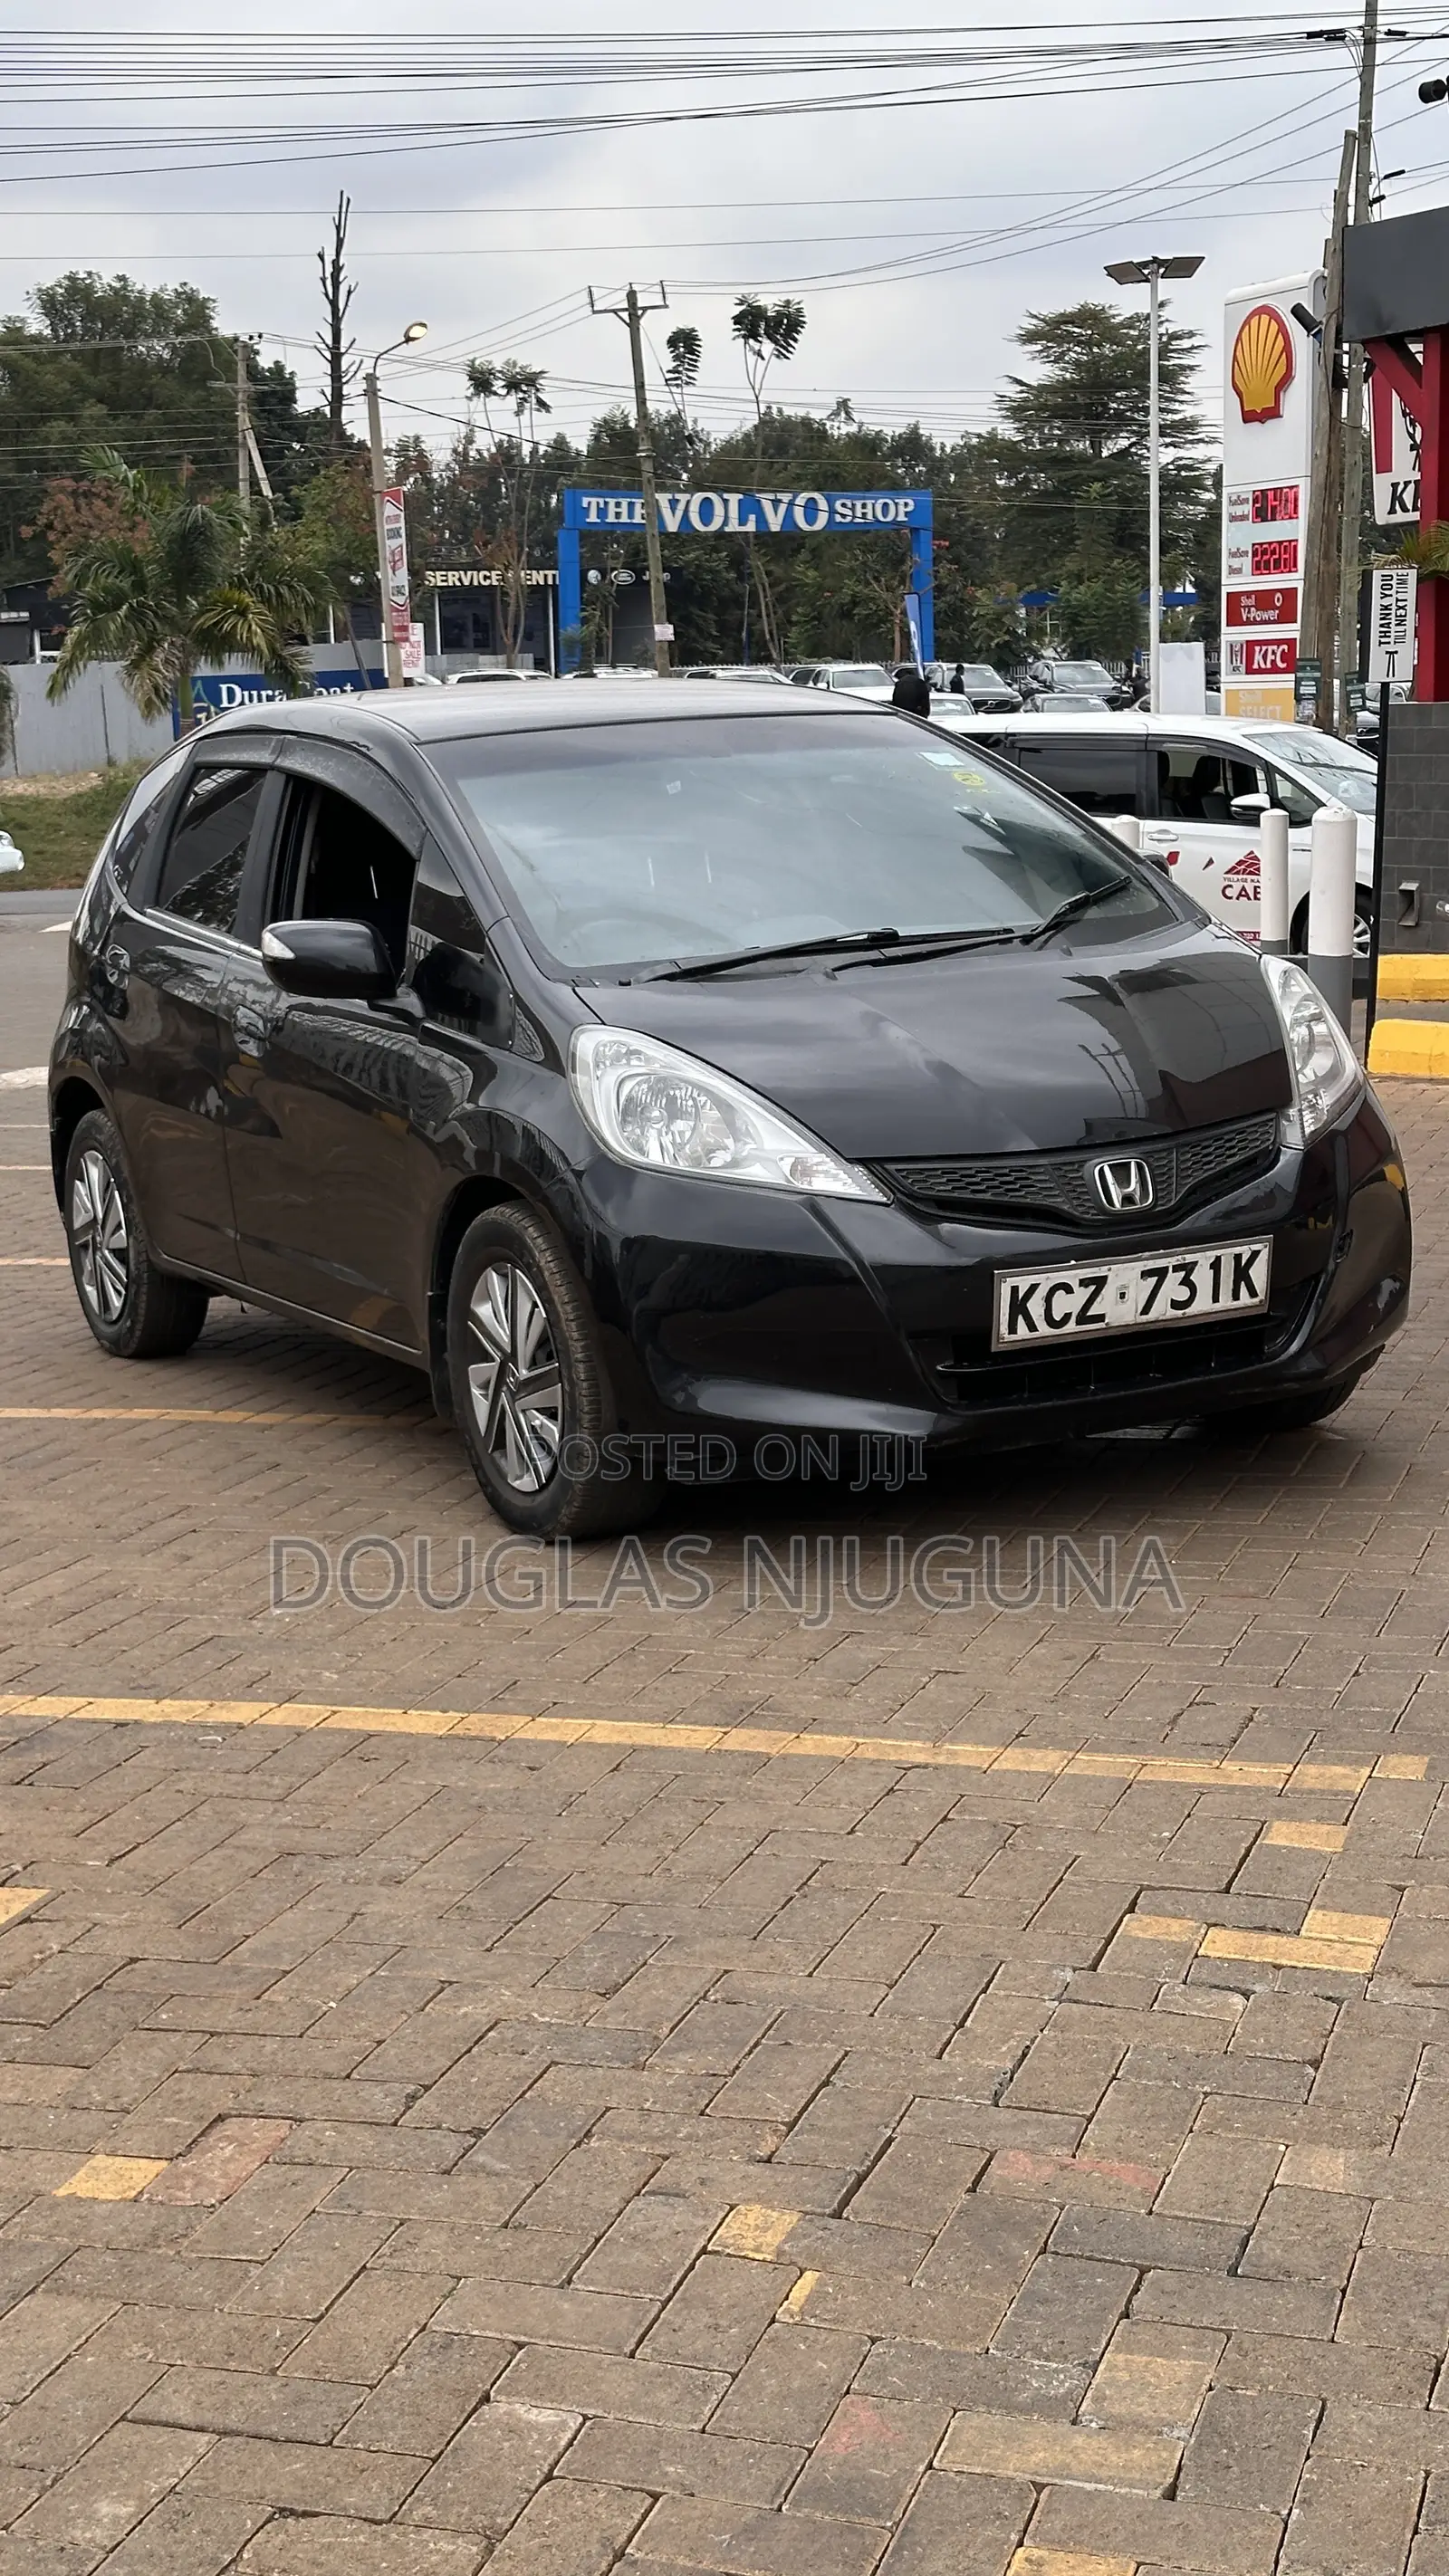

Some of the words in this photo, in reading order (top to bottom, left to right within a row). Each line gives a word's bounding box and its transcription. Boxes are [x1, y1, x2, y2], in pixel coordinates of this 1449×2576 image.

[655, 492, 830, 532] VOLVO
[834, 498, 915, 524] SHOP
[424, 570, 504, 587] SERVICE
[1379, 574, 1394, 599] YOU
[1396, 572, 1409, 595] TIME
[1241, 594, 1256, 606] Shell
[1395, 597, 1408, 627] NEXT
[1241, 608, 1279, 622] V-Power
[1378, 603, 1393, 646] THANK
[1394, 628, 1406, 645] TILL
[1252, 645, 1288, 669] KFC
[1007, 1275, 1108, 1336] KCZ
[1139, 1250, 1262, 1317] 731K
